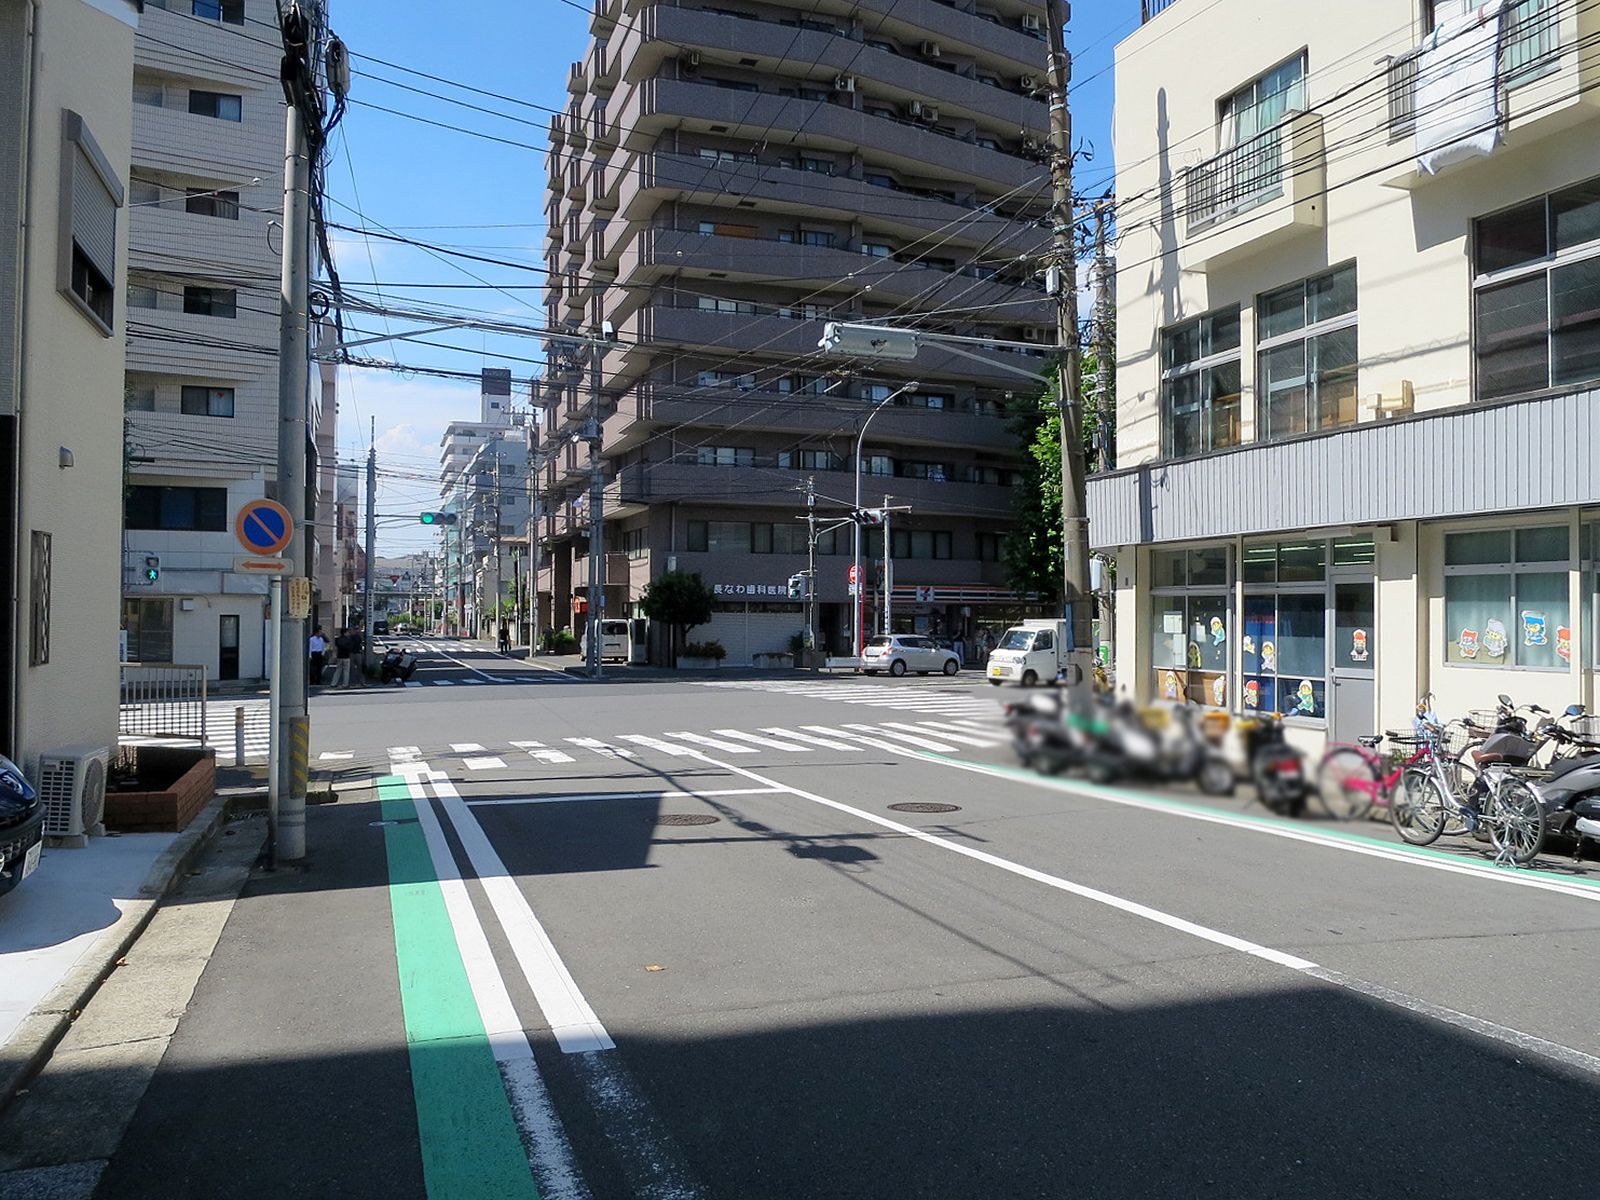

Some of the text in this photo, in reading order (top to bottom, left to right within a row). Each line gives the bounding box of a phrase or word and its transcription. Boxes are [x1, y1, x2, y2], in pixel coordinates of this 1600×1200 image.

[713, 584, 787, 595] 長なわ歯科医院
